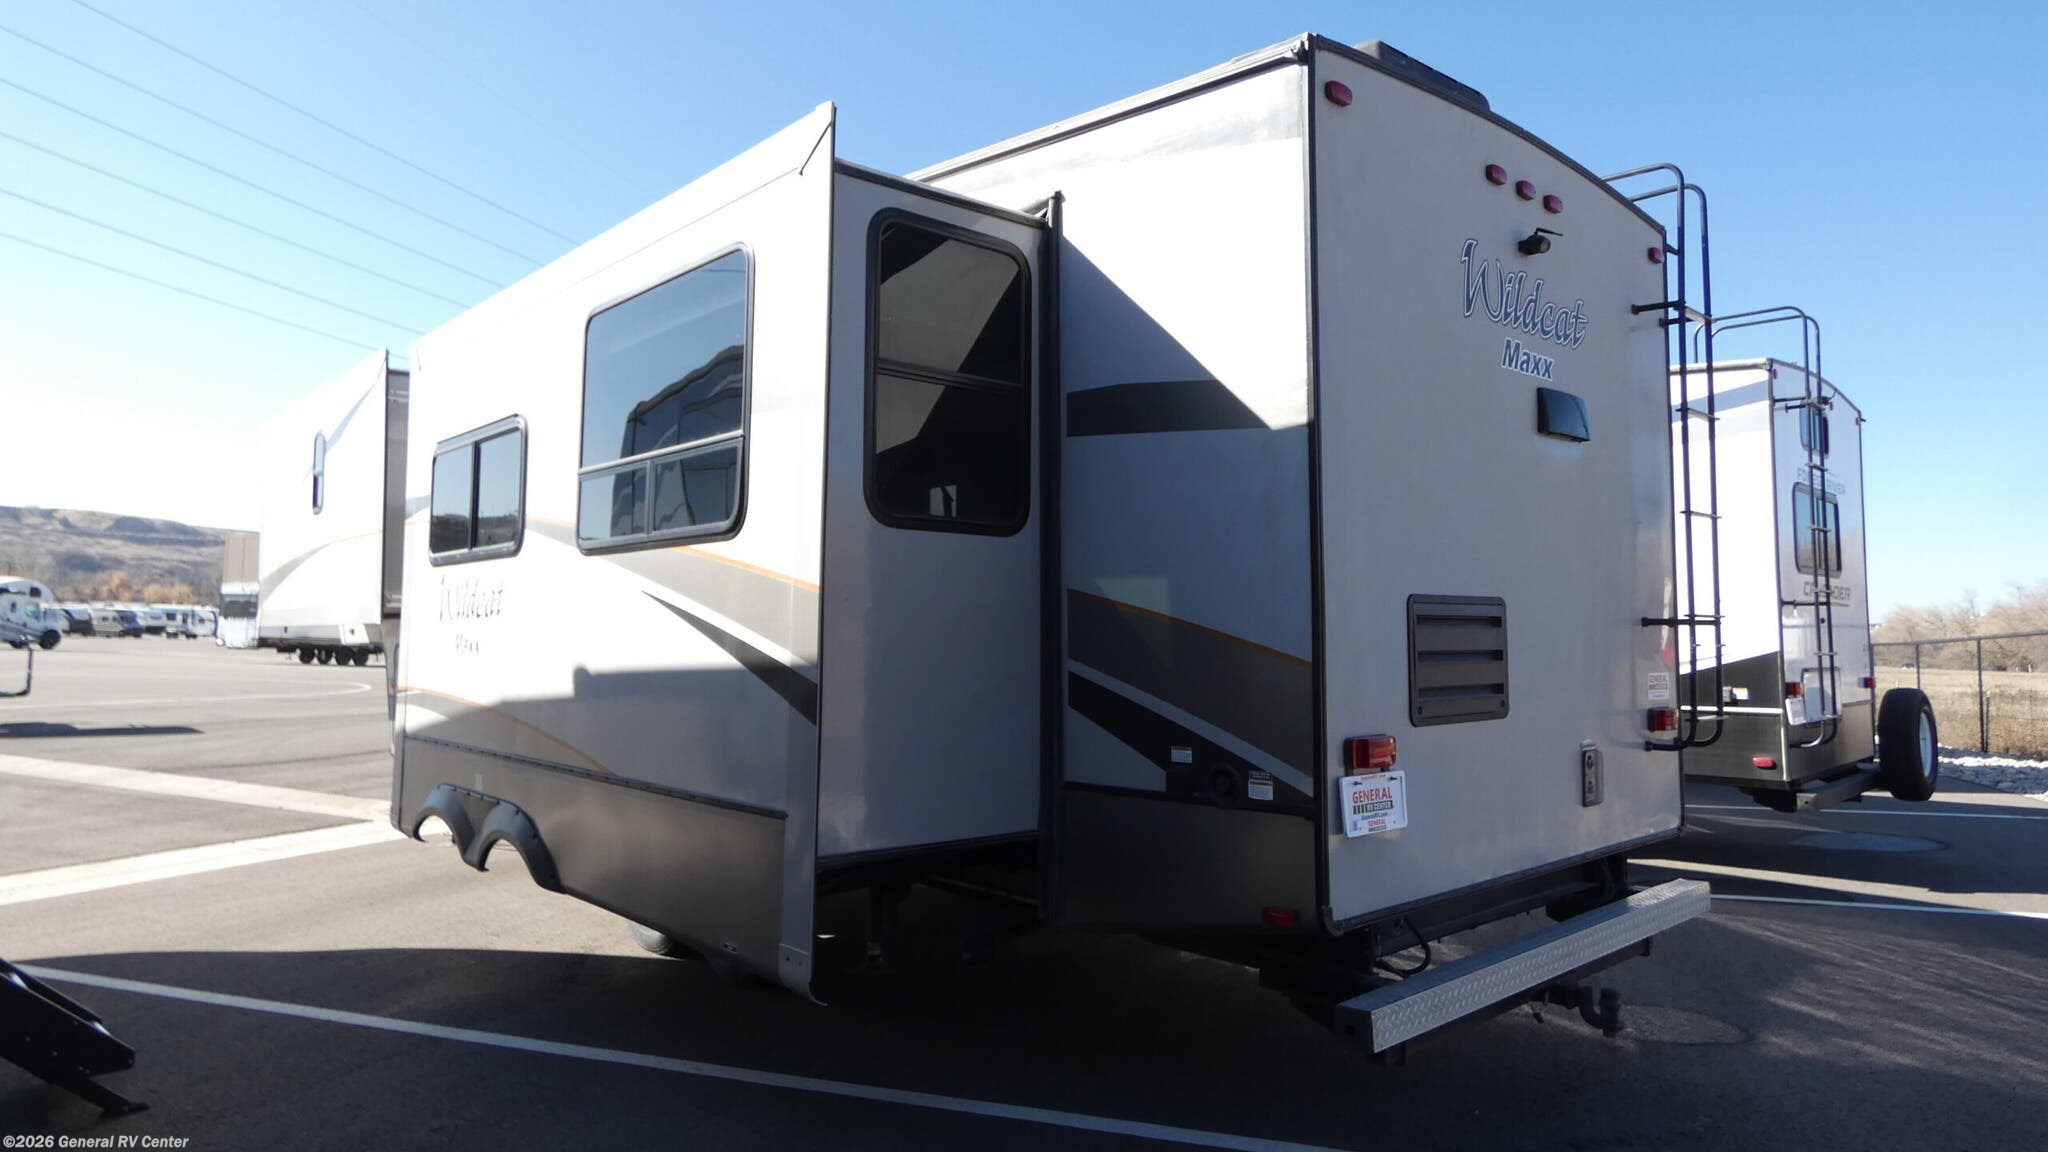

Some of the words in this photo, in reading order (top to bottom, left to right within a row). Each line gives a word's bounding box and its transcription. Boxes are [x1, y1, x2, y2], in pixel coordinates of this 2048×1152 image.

[1461, 238, 1589, 350] Wildcat
[1501, 337, 1555, 381] Maxx
[1804, 581, 1851, 600] CRSDER
[1352, 787, 1392, 804] GENERAL
